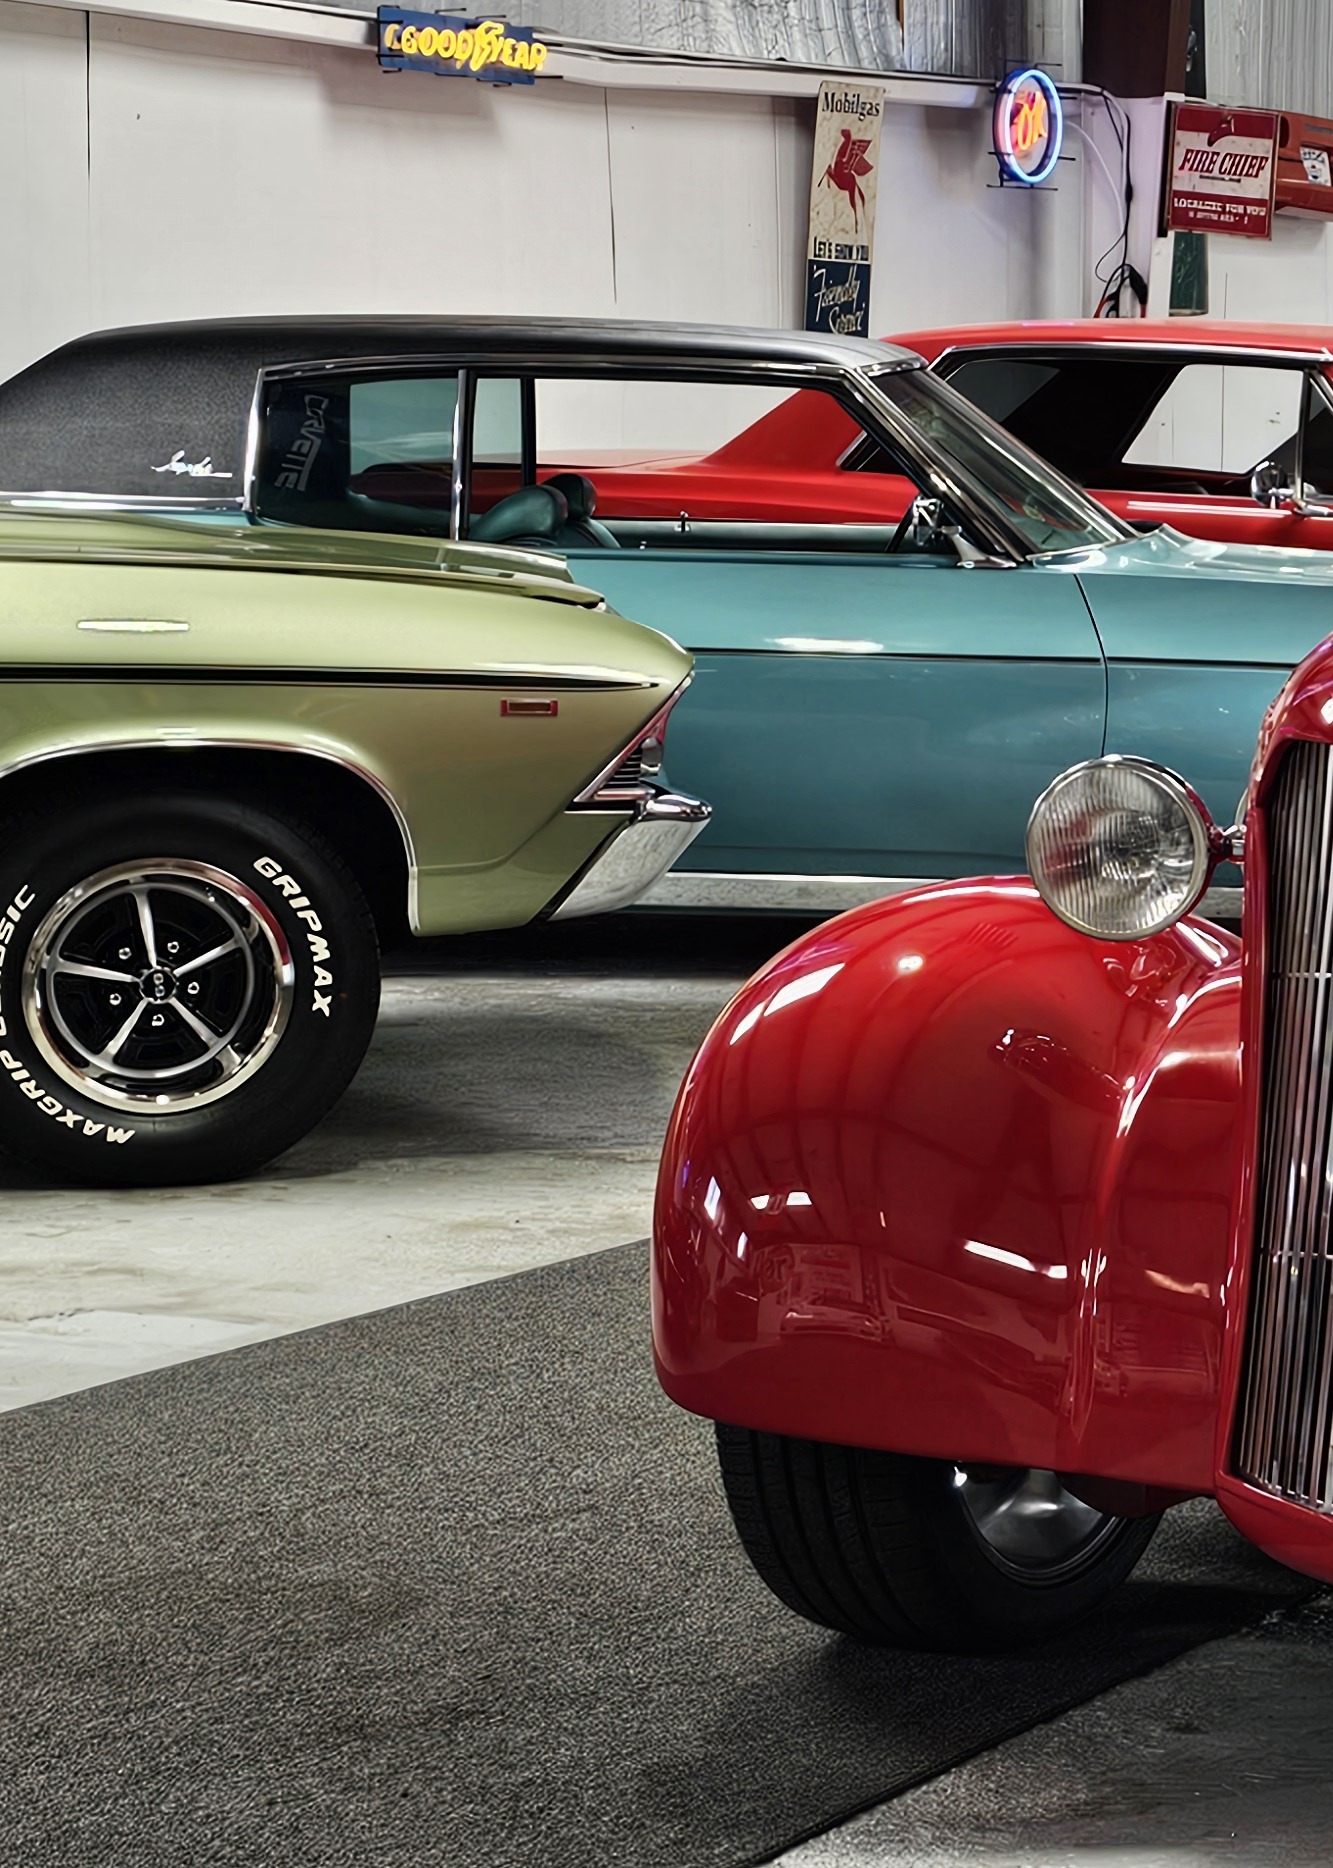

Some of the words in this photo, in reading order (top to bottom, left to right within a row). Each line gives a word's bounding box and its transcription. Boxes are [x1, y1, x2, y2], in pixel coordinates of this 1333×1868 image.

[401, 21, 547, 71] GOODYEAR
[822, 92, 881, 121] Mobilgas
[1178, 149, 1220, 174] FIRE
[1218, 152, 1269, 178] CHIEF
[253, 856, 333, 1017] GRIPMAX
